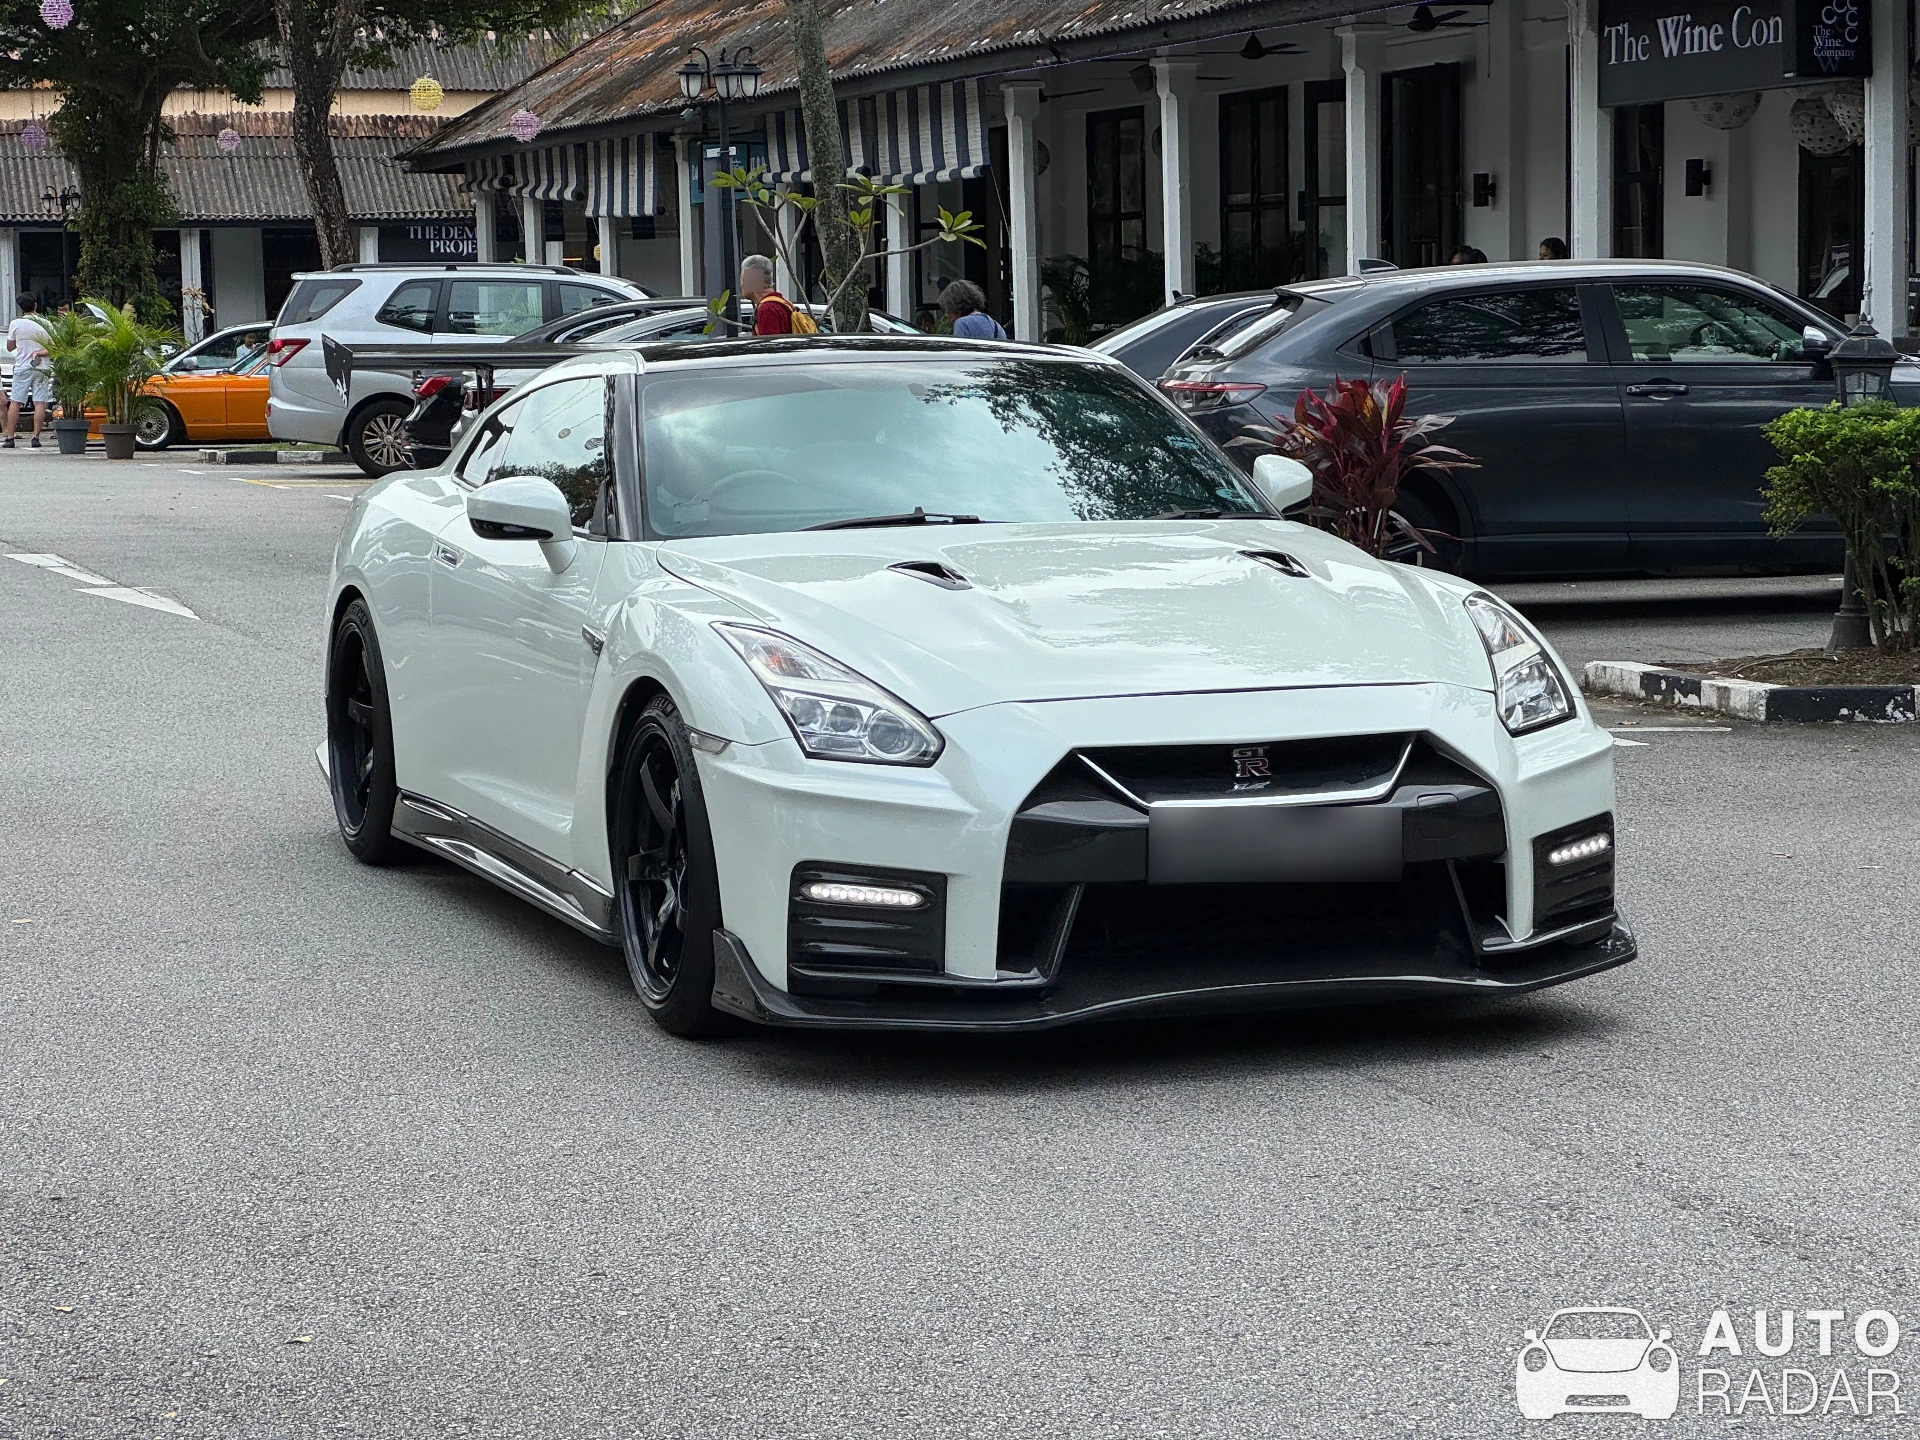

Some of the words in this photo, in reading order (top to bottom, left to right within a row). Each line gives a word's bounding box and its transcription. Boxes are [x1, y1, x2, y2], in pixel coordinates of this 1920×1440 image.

[1812, 25, 1831, 36] The
[1604, 22, 1650, 65] The
[1656, 13, 1724, 58] Wine
[1813, 35, 1842, 47] Wine
[1813, 46, 1856, 60] Company
[406, 225, 439, 240] THE
[430, 239, 477, 256] PROJE
[1232, 746, 1269, 758] GT
[1234, 757, 1272, 778] R
